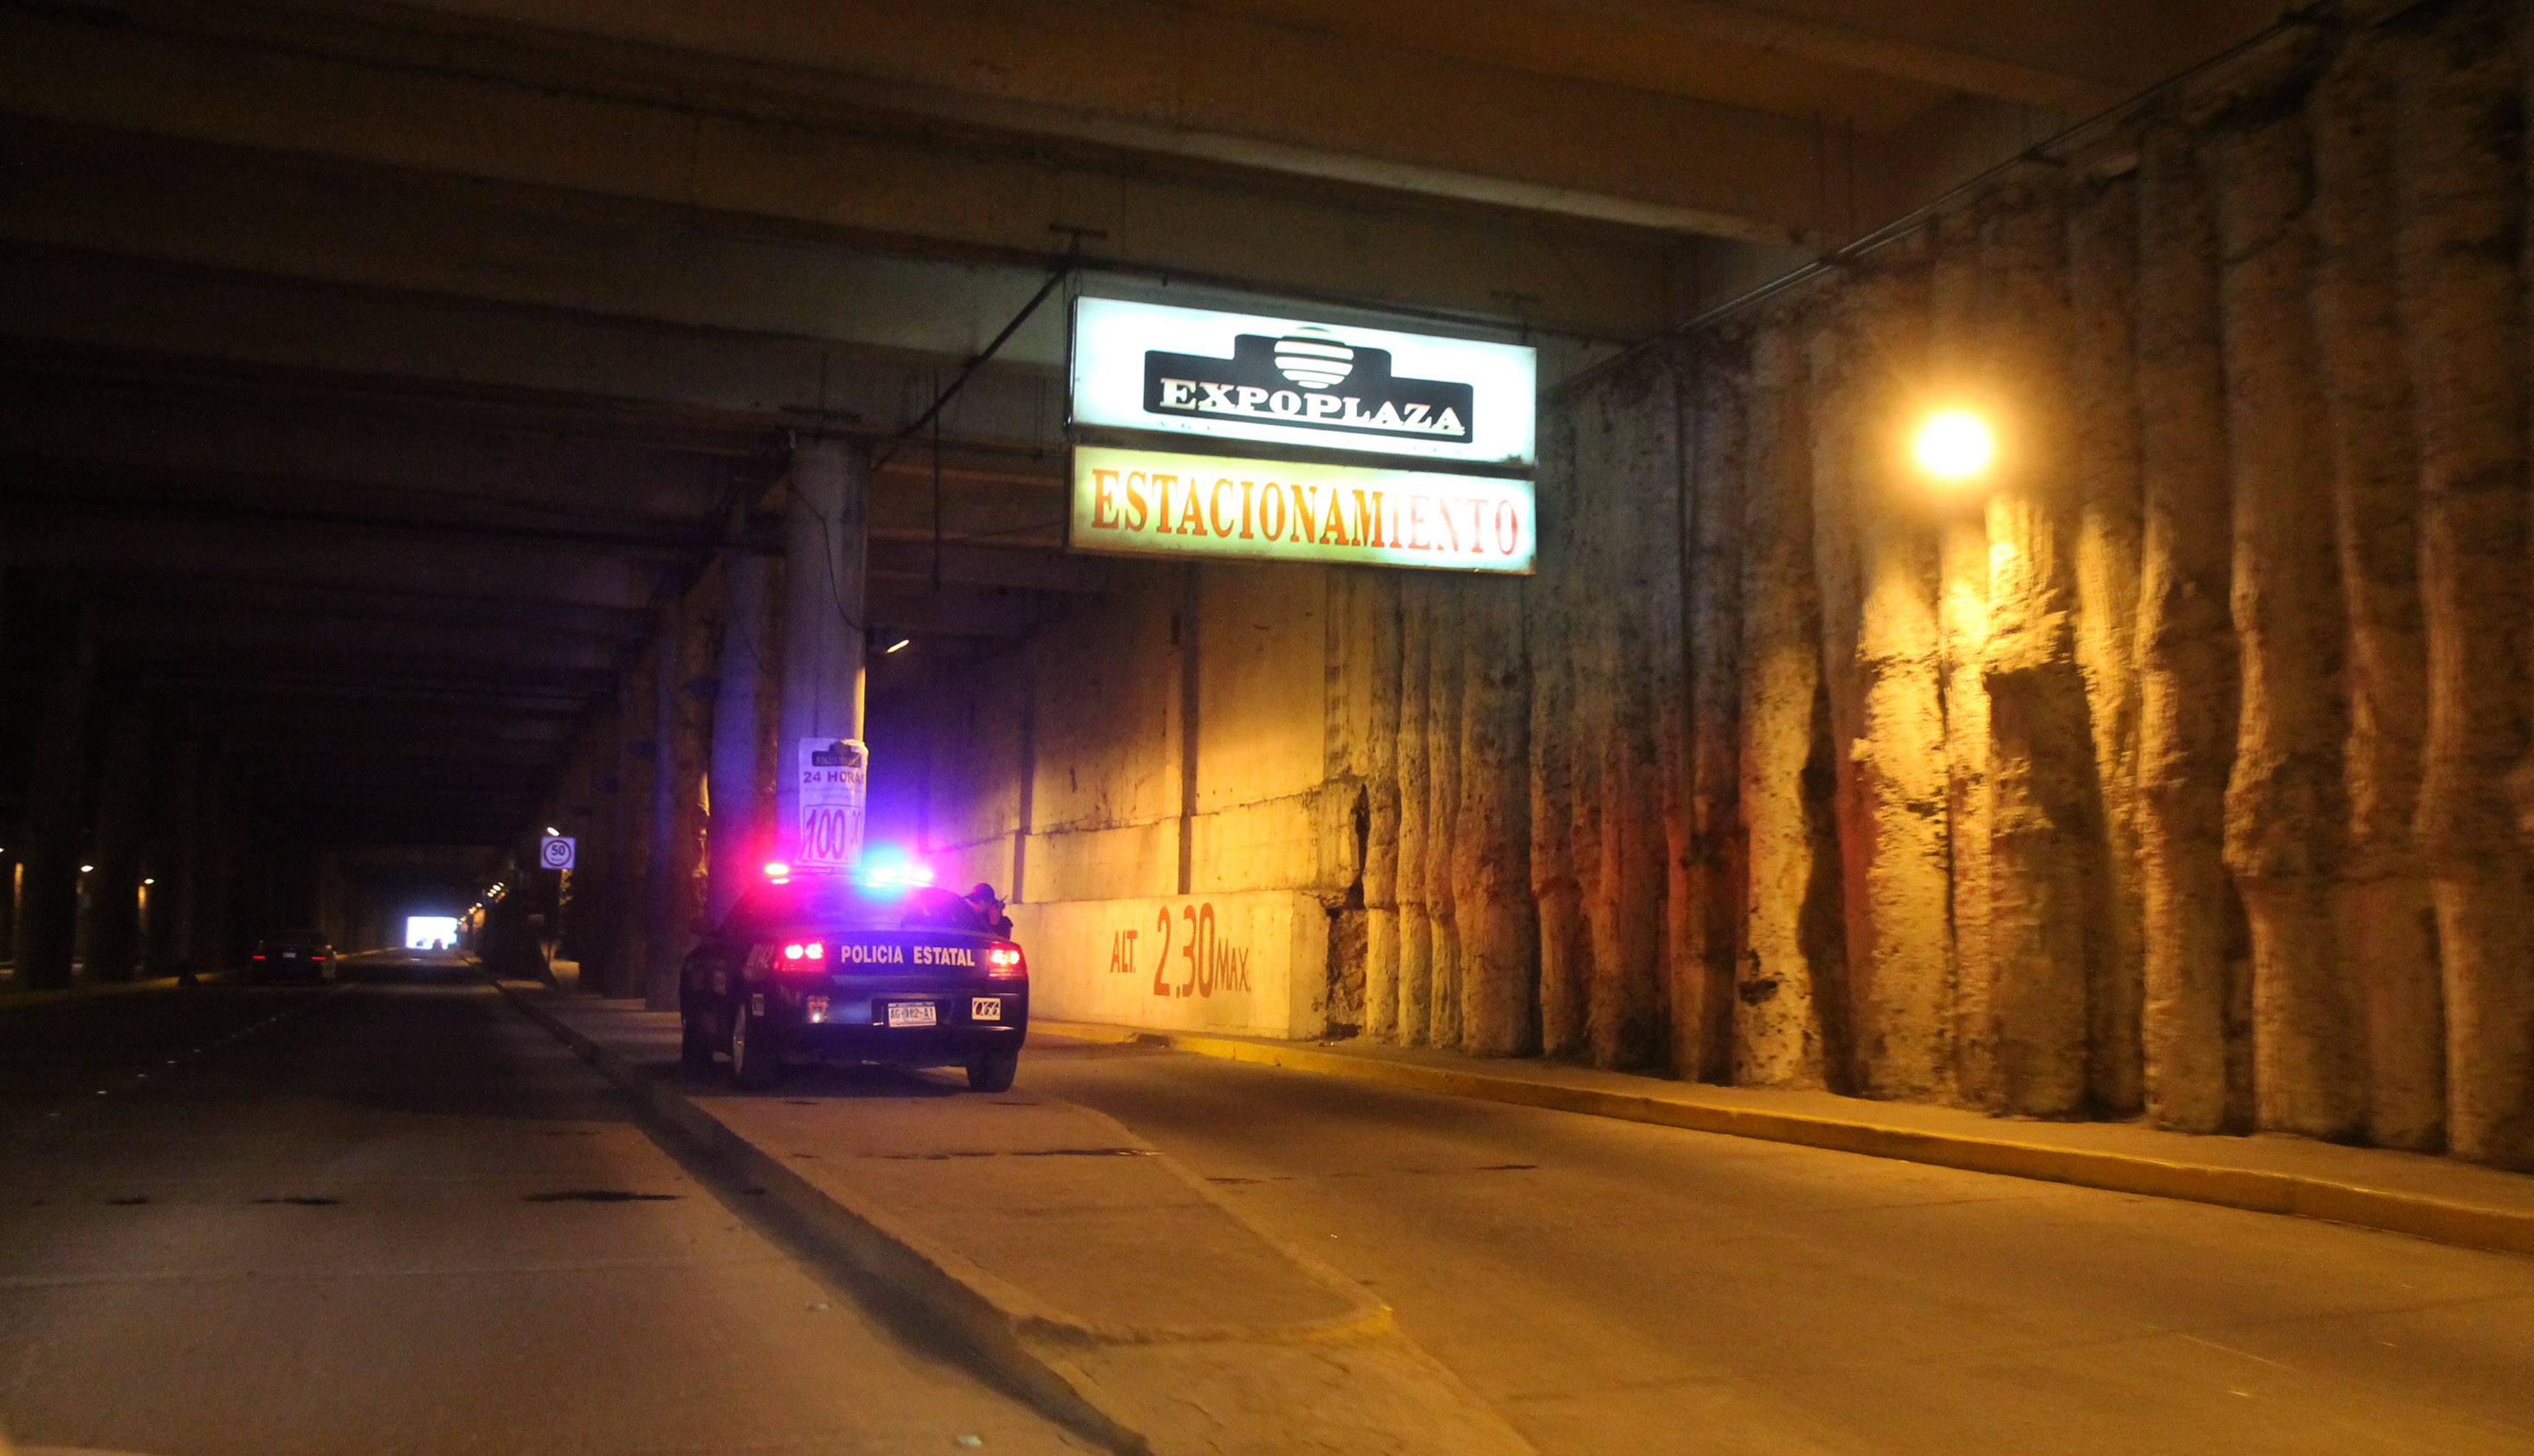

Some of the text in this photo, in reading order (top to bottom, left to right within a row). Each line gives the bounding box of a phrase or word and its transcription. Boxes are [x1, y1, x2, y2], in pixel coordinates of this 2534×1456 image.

[1159, 377, 1466, 430] EXPOPLAZA
[1091, 468, 1518, 556] ESTACIONAMIENTO
[803, 771, 821, 783] 24
[551, 845, 565, 855] 50
[841, 945, 976, 966] POLICIA ESTATAL
[1154, 902, 1215, 999] 2.30
